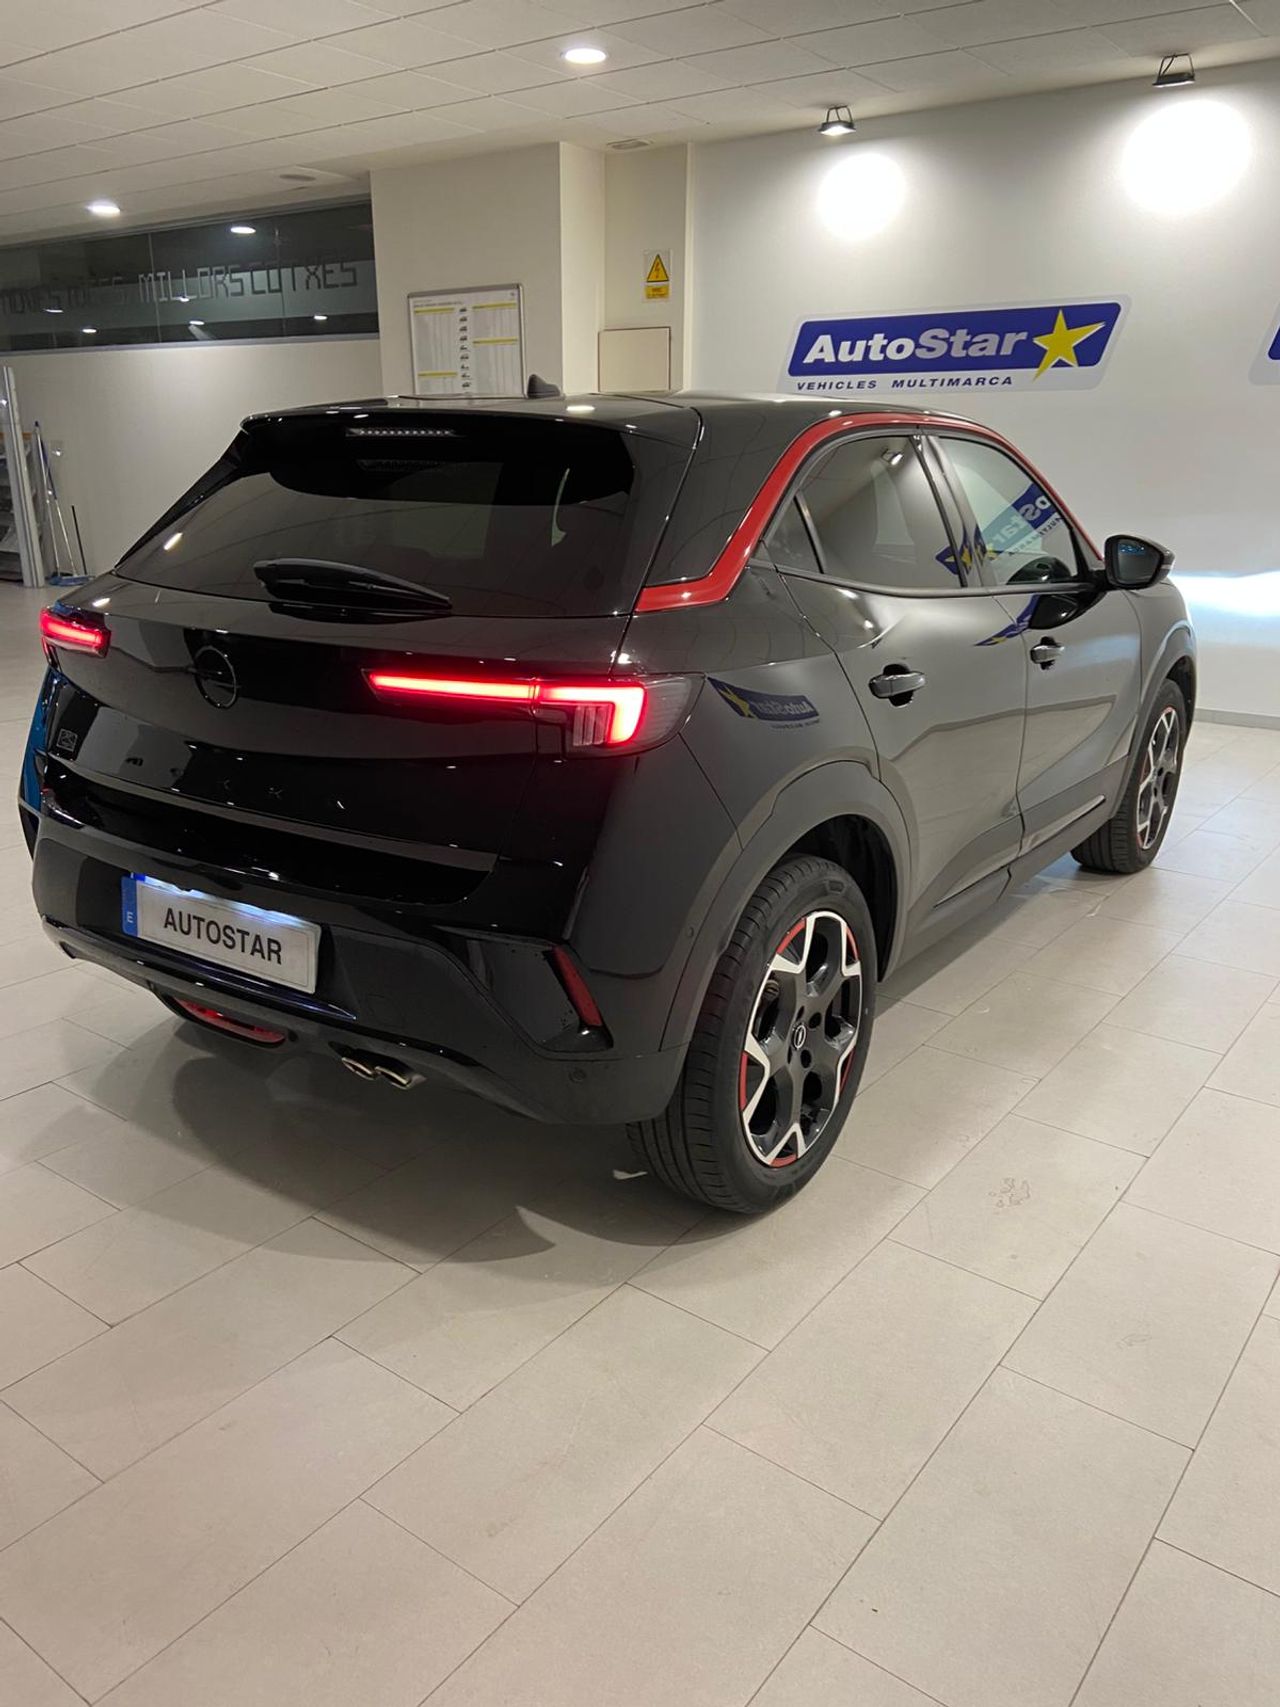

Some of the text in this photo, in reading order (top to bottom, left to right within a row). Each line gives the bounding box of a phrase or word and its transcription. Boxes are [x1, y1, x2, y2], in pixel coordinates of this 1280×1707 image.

[802, 327, 1028, 365] AutoStar
[796, 375, 1014, 391] VEHICLES MULTIMARCA
[126, 911, 134, 924] E
[163, 907, 283, 966] AUTOSTAR
